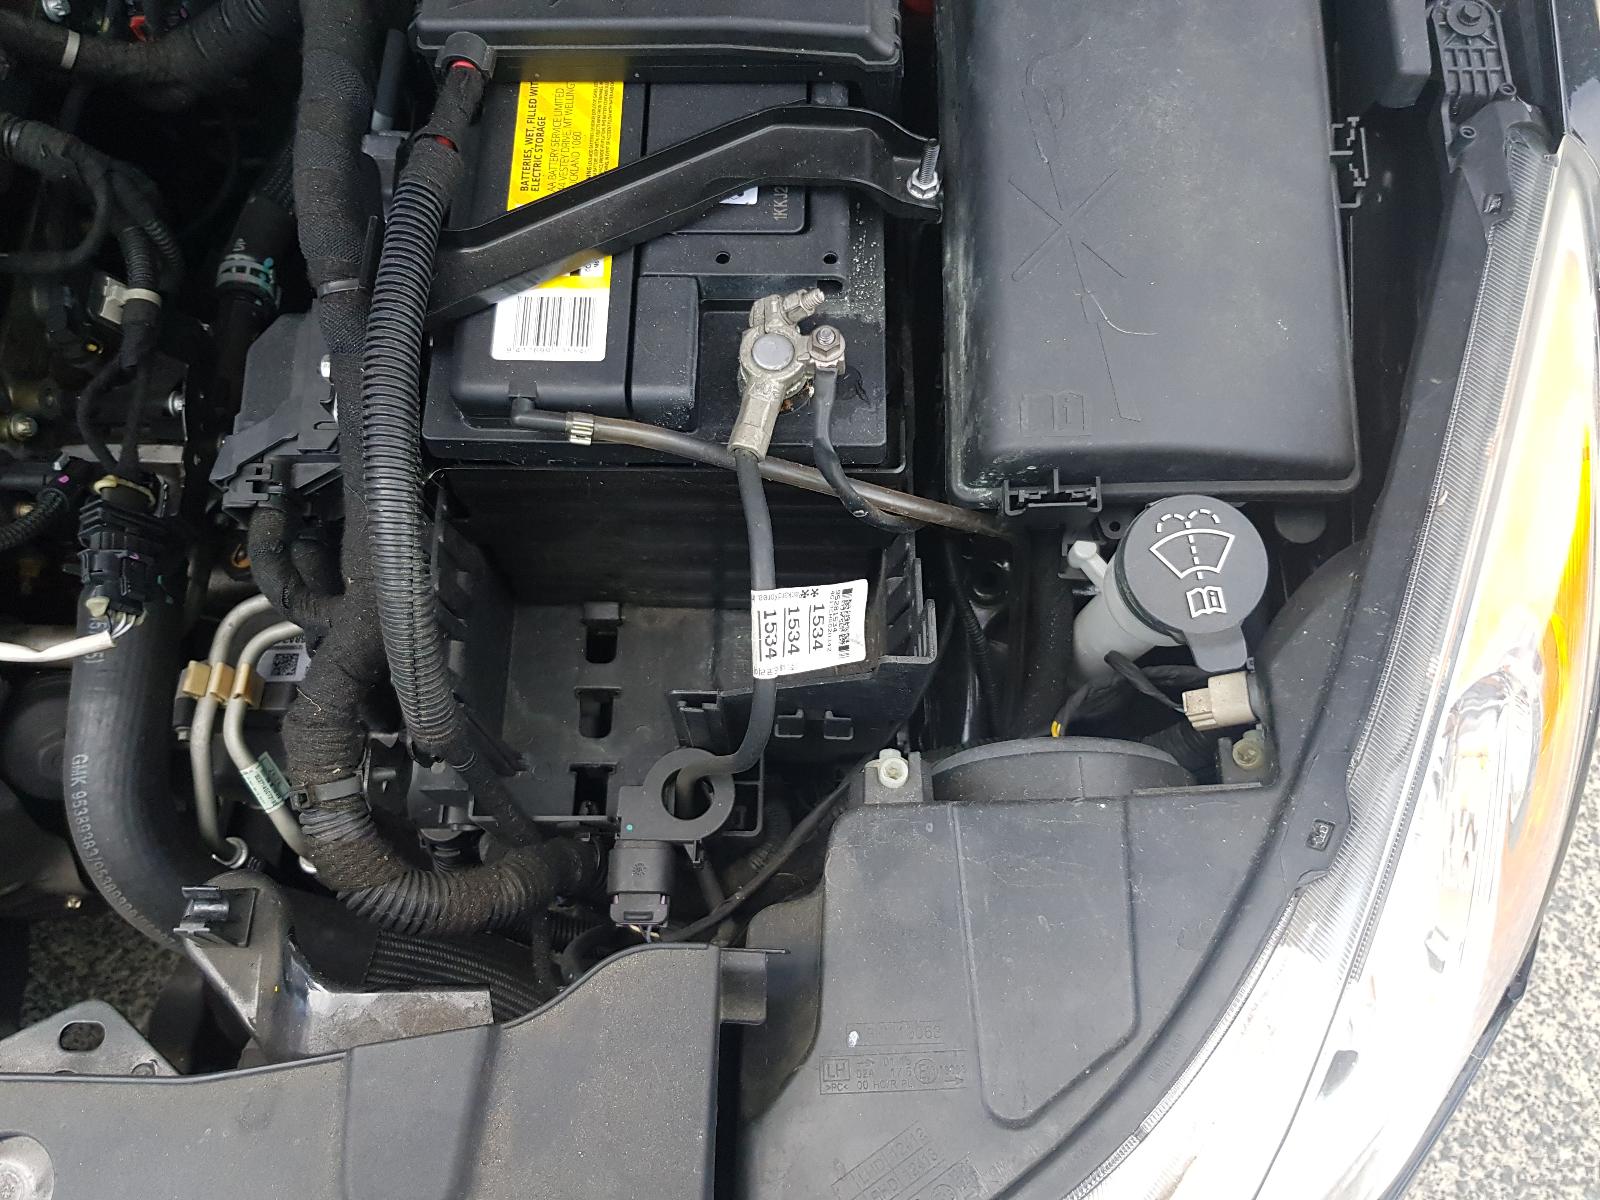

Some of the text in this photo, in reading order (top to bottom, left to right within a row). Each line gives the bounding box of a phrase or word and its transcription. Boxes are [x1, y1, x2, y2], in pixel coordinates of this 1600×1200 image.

[526, 98, 538, 124] FILLED
[553, 88, 565, 117] LIMITED
[525, 126, 536, 145] WET,
[550, 118, 563, 147] SERVICE
[563, 116, 573, 129] MT
[531, 116, 546, 192] ELECTRIC STORAGE
[571, 131, 582, 150] 1060
[520, 147, 535, 192] BATTERIES,
[548, 148, 560, 179] BATTERY
[558, 154, 571, 181] VESTEY
[763, 609, 778, 660] 1534
[787, 606, 800, 656] 1534
[812, 603, 825, 652] 1534
[70, 753, 89, 787] GMK
